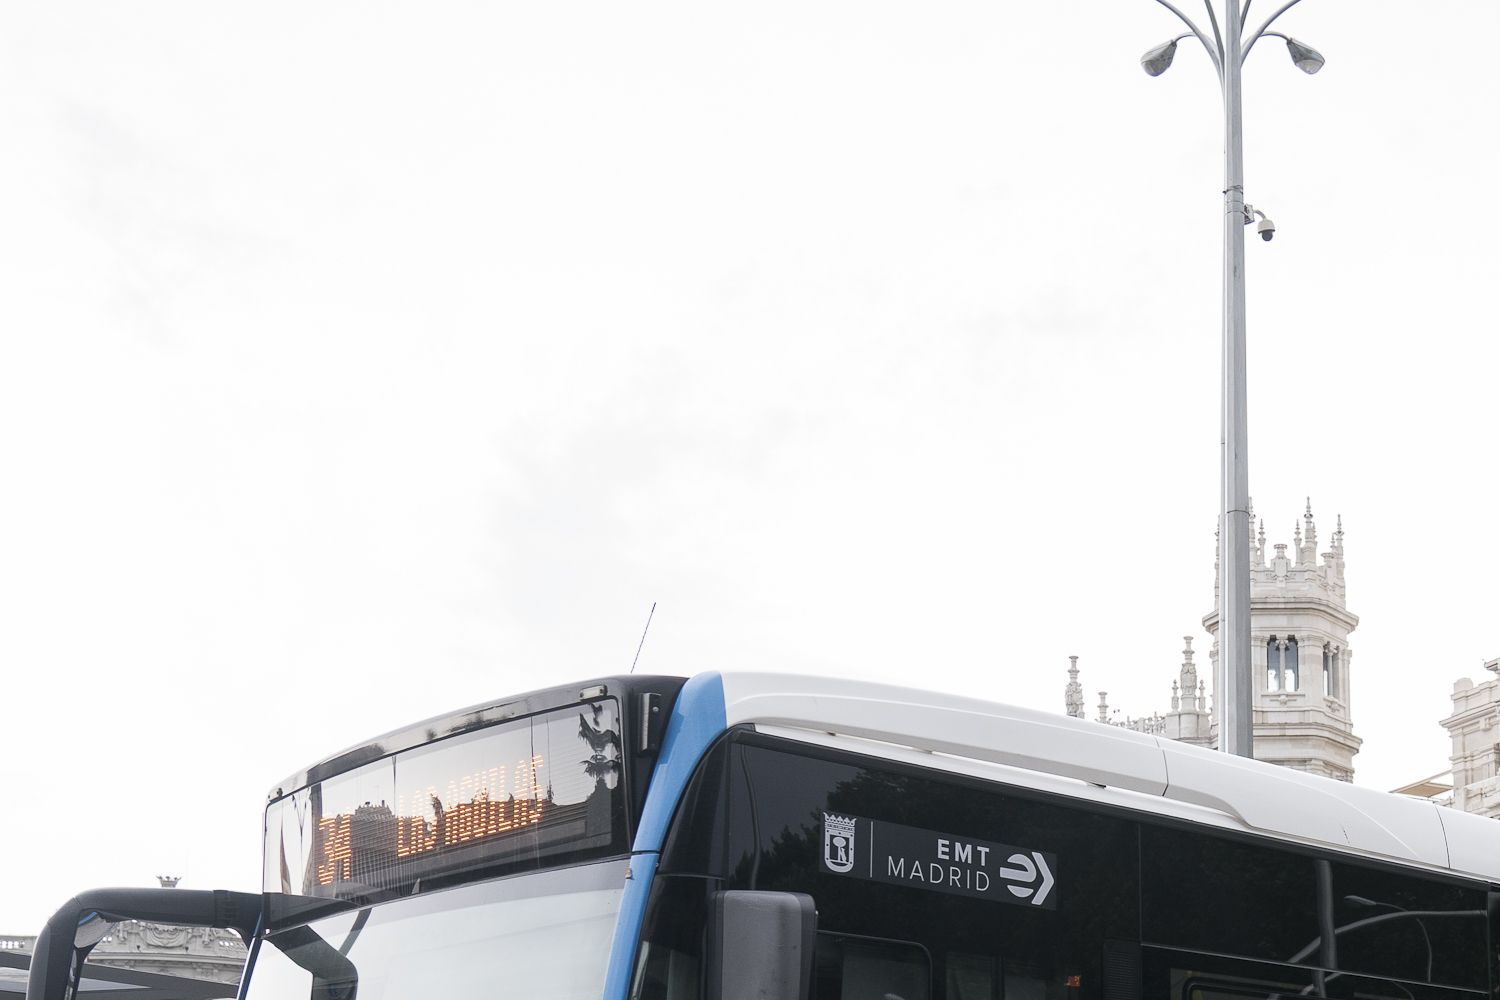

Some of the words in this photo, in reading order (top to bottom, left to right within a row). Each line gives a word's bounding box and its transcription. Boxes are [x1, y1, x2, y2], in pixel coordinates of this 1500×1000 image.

[318, 810, 352, 886] 34
[397, 785, 437, 857] LAS
[938, 838, 990, 867] EMT
[888, 855, 990, 892] MADRID
